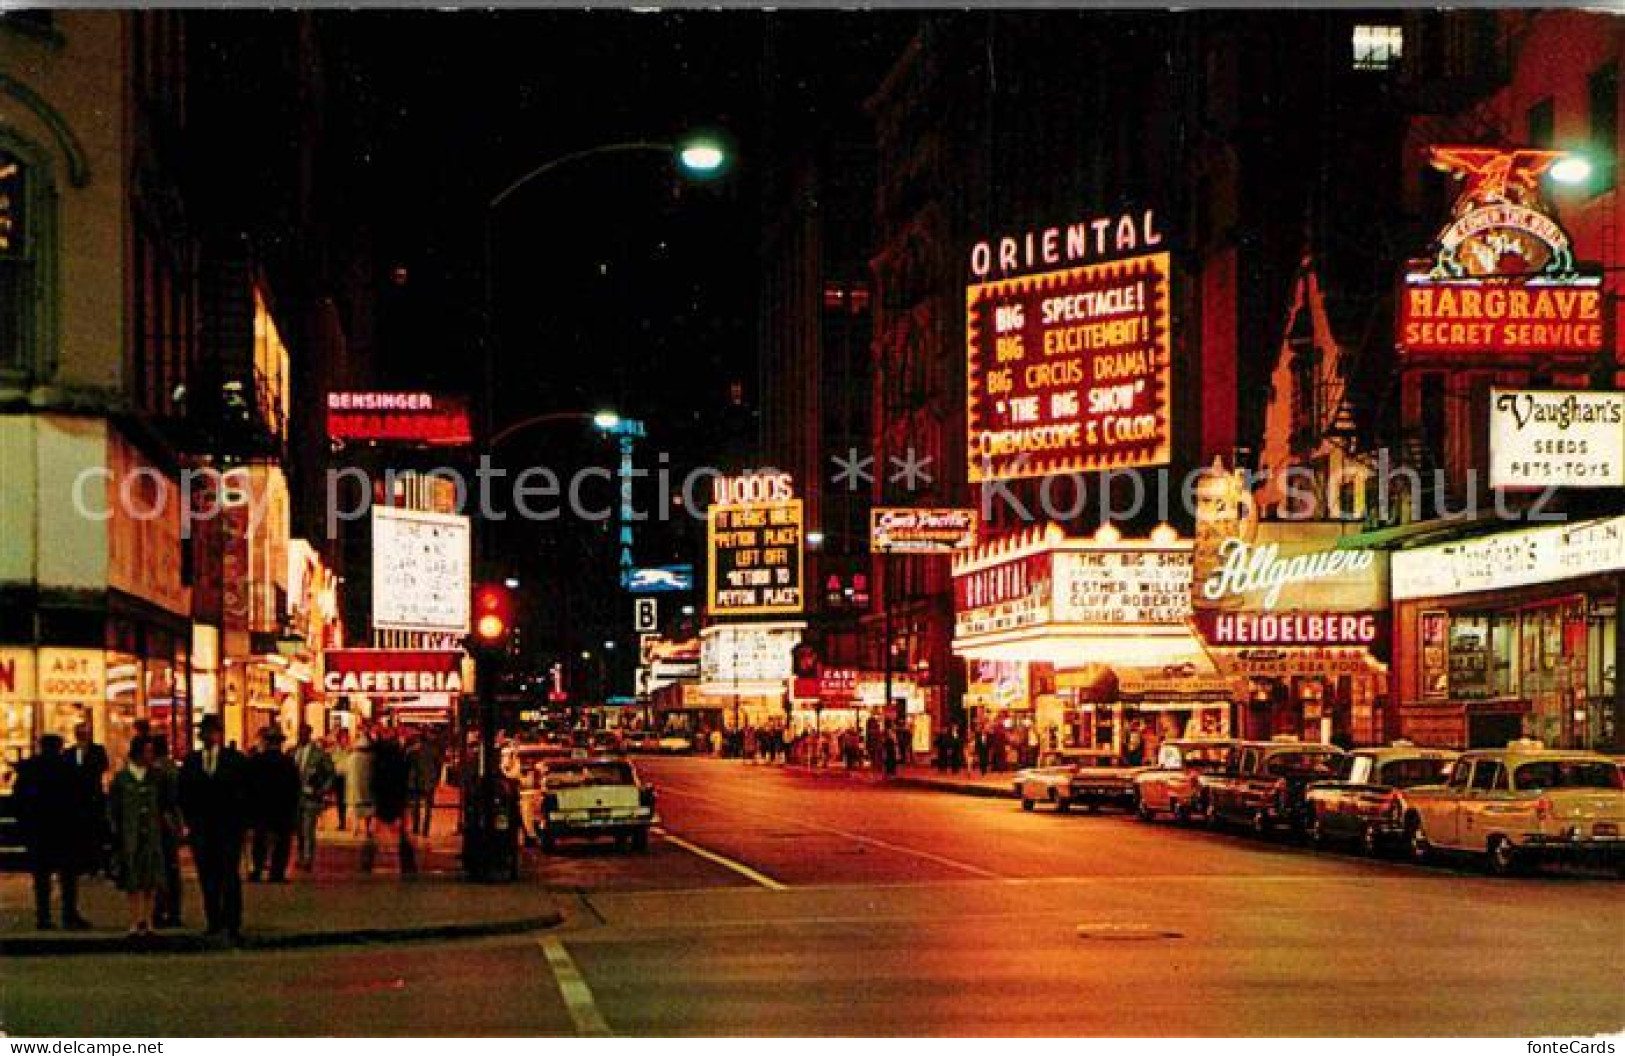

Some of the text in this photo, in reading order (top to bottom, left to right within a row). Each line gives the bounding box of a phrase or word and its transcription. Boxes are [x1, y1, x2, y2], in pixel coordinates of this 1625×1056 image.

[972, 209, 1161, 275] ORIENTAL
[996, 281, 1145, 332] BIG SPECTACLE!
[1410, 288, 1599, 318] HARGRAVE
[996, 316, 1149, 362] BIG EXCITEMENT!
[1407, 323, 1602, 345] SECRET SERVICE
[987, 348, 1154, 394] BIG CIRCUS DRAMA!
[328, 392, 433, 410] BENSINGER
[1051, 390, 1078, 418] BIG
[1497, 395, 1621, 430] Vaughan's
[1103, 415, 1156, 444] COLOR
[1534, 440, 1588, 453] SEEDS
[714, 475, 793, 505] WOODS
[1080, 554, 1106, 567] THE
[1121, 554, 1145, 567] BIG
[1072, 581, 1127, 593] ESTHER
[1070, 595, 1187, 606] CLIFF ROBERTS
[1084, 609, 1125, 621] DAVID
[1216, 615, 1375, 642] HEIDELBERG
[53, 657, 88, 671] ART
[45, 680, 97, 694] GOODS
[325, 671, 461, 691] CAFETERIA
